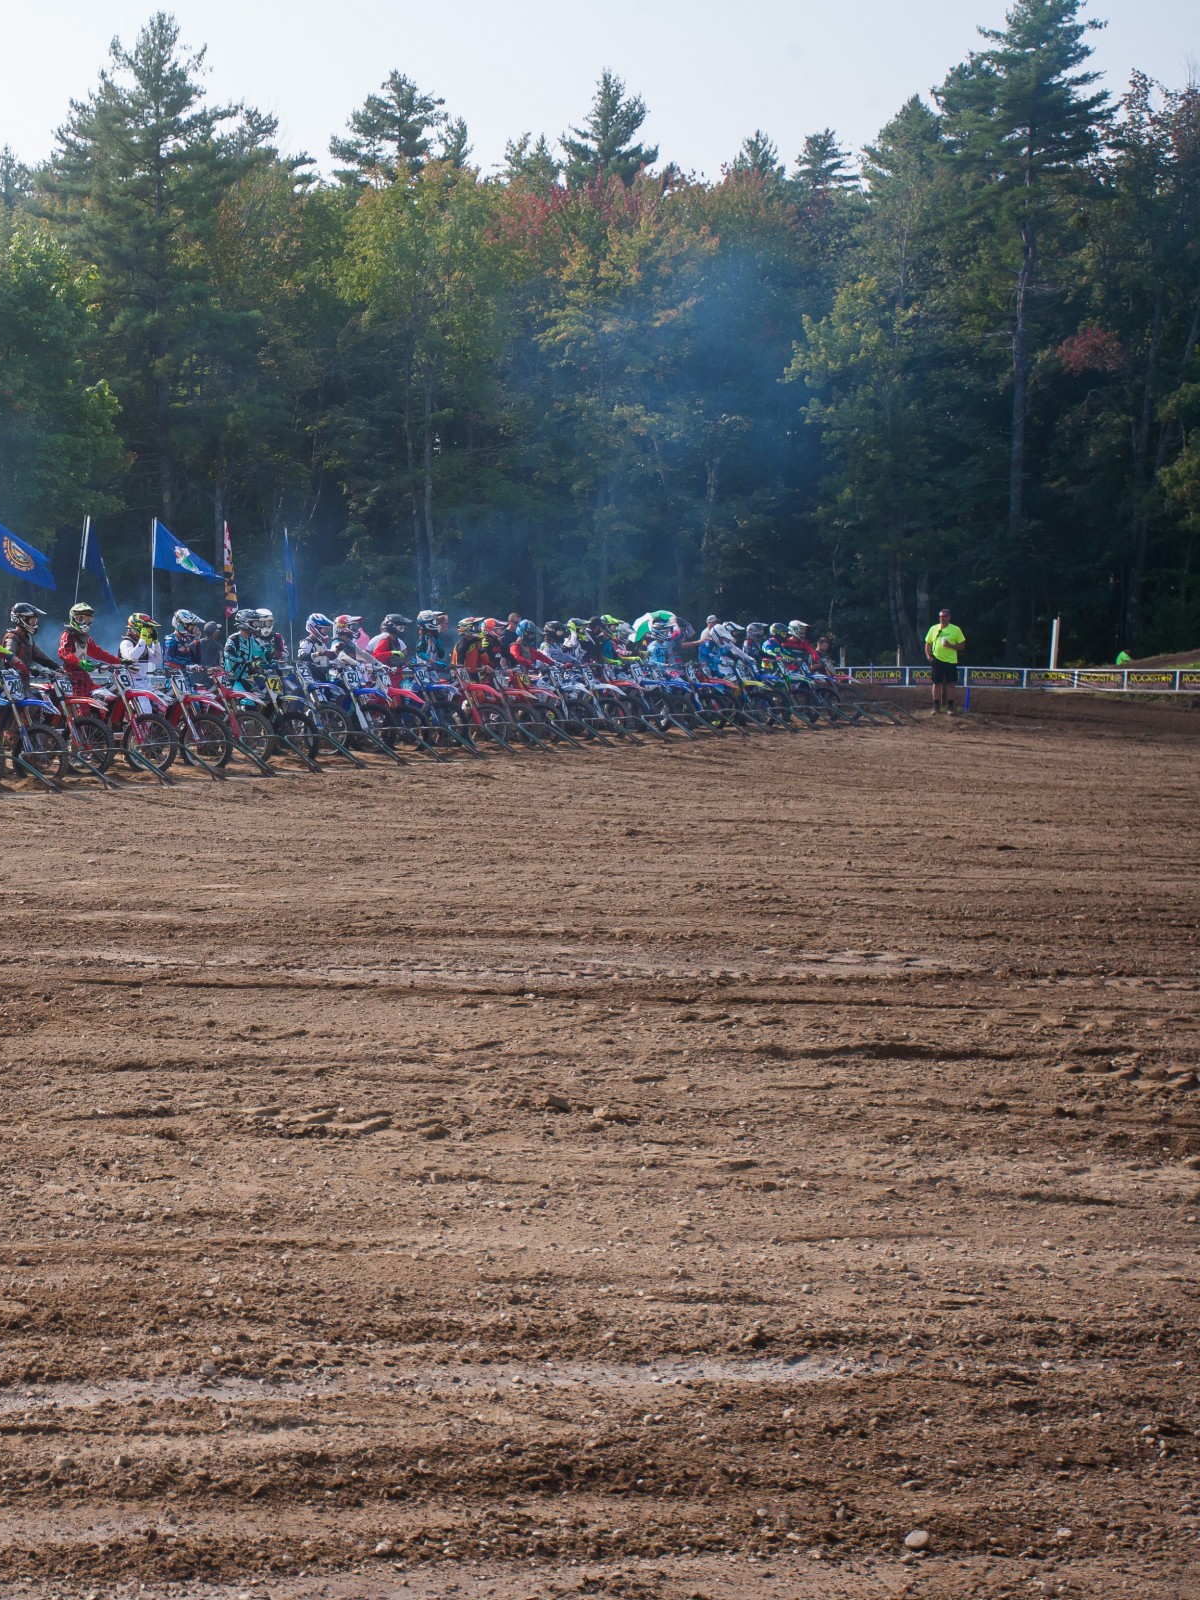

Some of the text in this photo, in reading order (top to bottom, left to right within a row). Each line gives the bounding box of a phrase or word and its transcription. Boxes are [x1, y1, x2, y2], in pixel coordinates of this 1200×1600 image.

[971, 671, 1019, 680] ROCKSTAR
[1130, 673, 1173, 683] ROCKSTAR
[120, 674, 130, 688] 9
